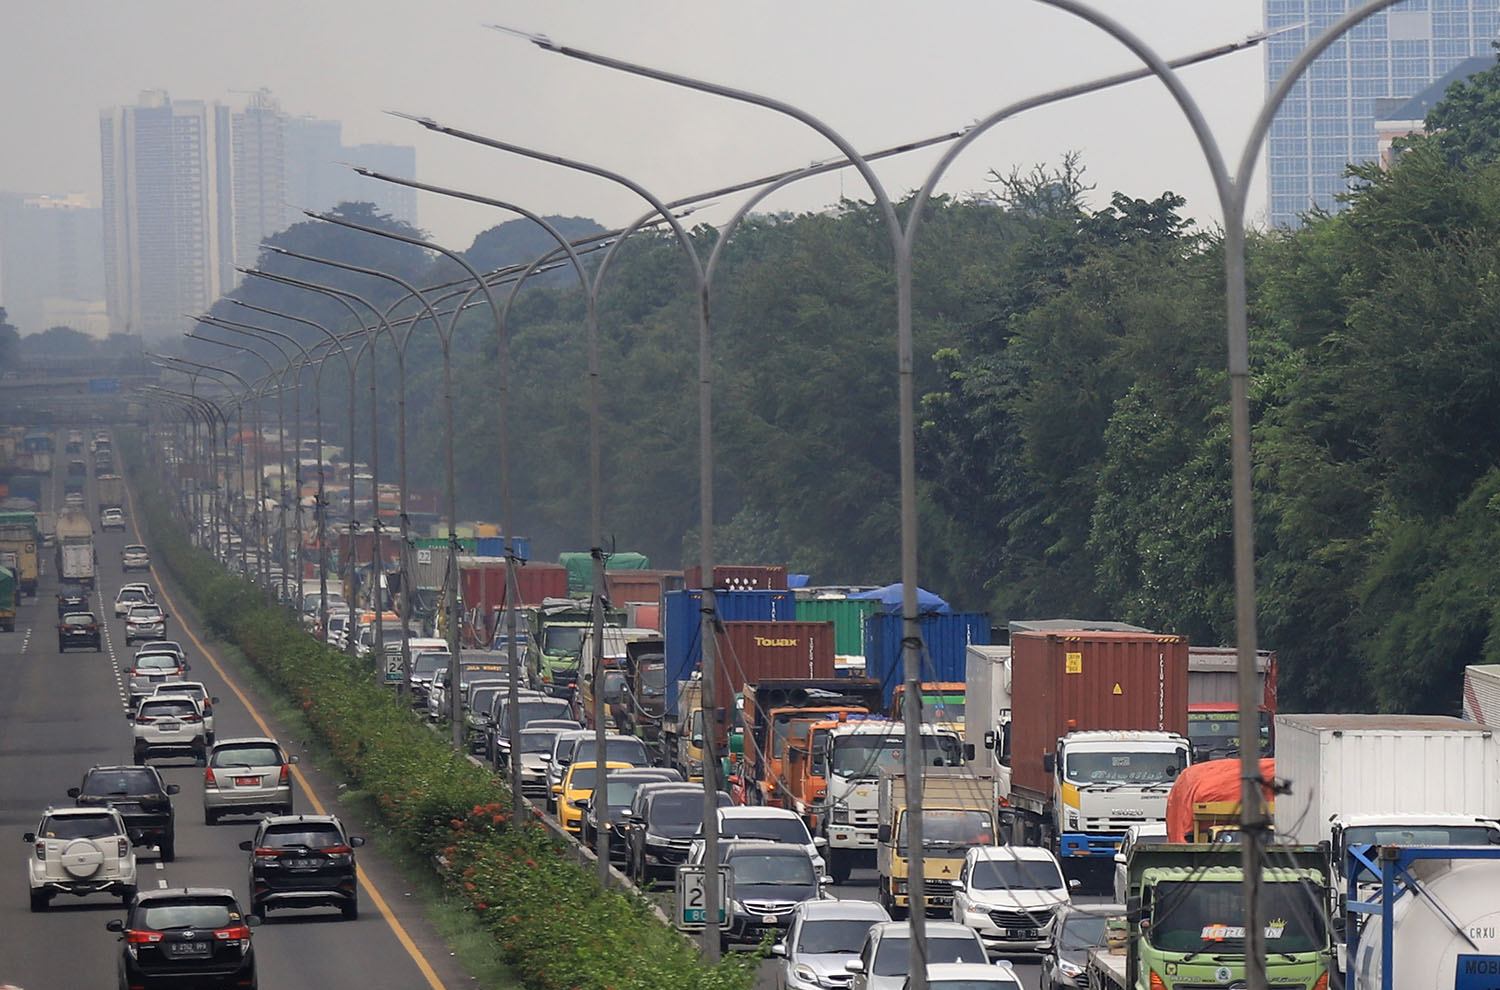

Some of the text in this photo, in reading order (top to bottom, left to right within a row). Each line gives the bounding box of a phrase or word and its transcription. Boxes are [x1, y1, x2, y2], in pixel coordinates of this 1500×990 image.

[754, 637, 798, 647] Touax
[1111, 808, 1143, 816] ISUZU
[1470, 927, 1495, 939] CRXU
